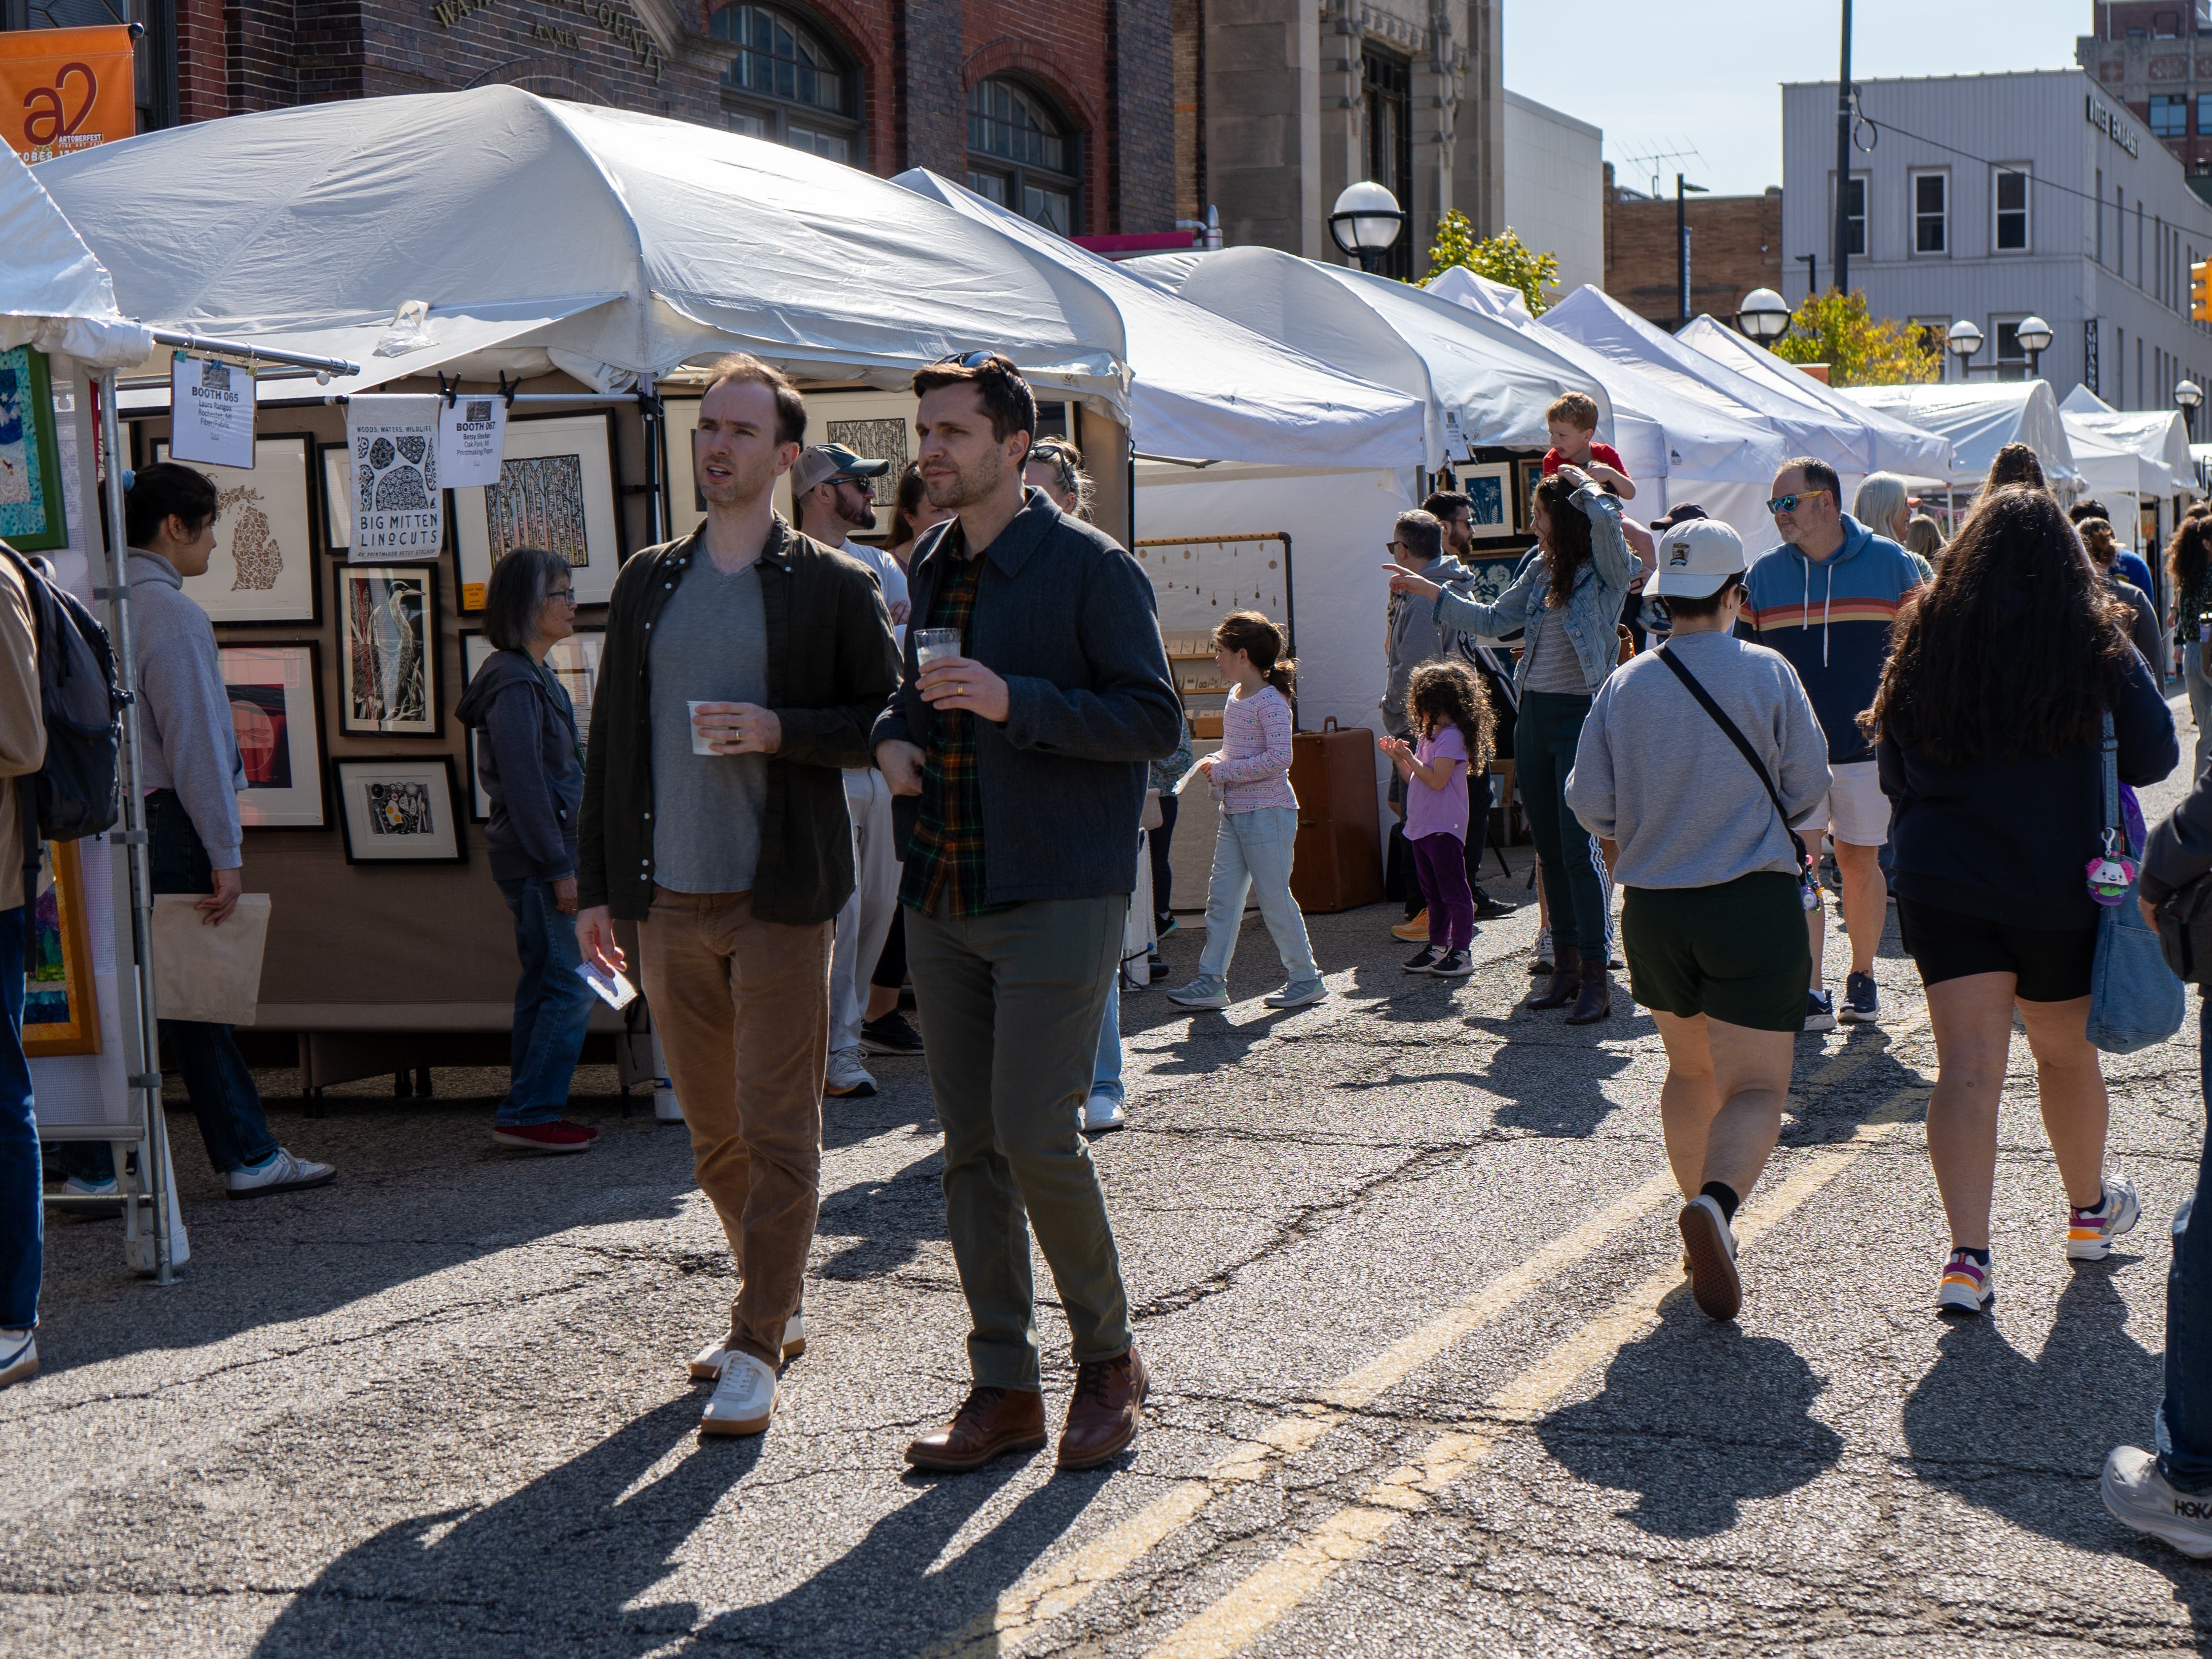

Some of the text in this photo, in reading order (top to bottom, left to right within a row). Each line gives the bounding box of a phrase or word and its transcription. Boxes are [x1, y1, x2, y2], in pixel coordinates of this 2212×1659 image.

[534, 23, 580, 49] ANNEX
[59, 133, 102, 143] ARTOBERFEST
[192, 386, 221, 400] BOOTH
[224, 392, 238, 403] 065
[199, 400, 232, 413] Laura Rangos
[199, 409, 224, 421] Rochester,
[200, 418, 229, 429] Fiber/Fabric
[456, 422, 496, 431] BOOTH 067
[361, 513, 438, 530] BIG MITTEN
[361, 530, 438, 547] LINOCUTS
